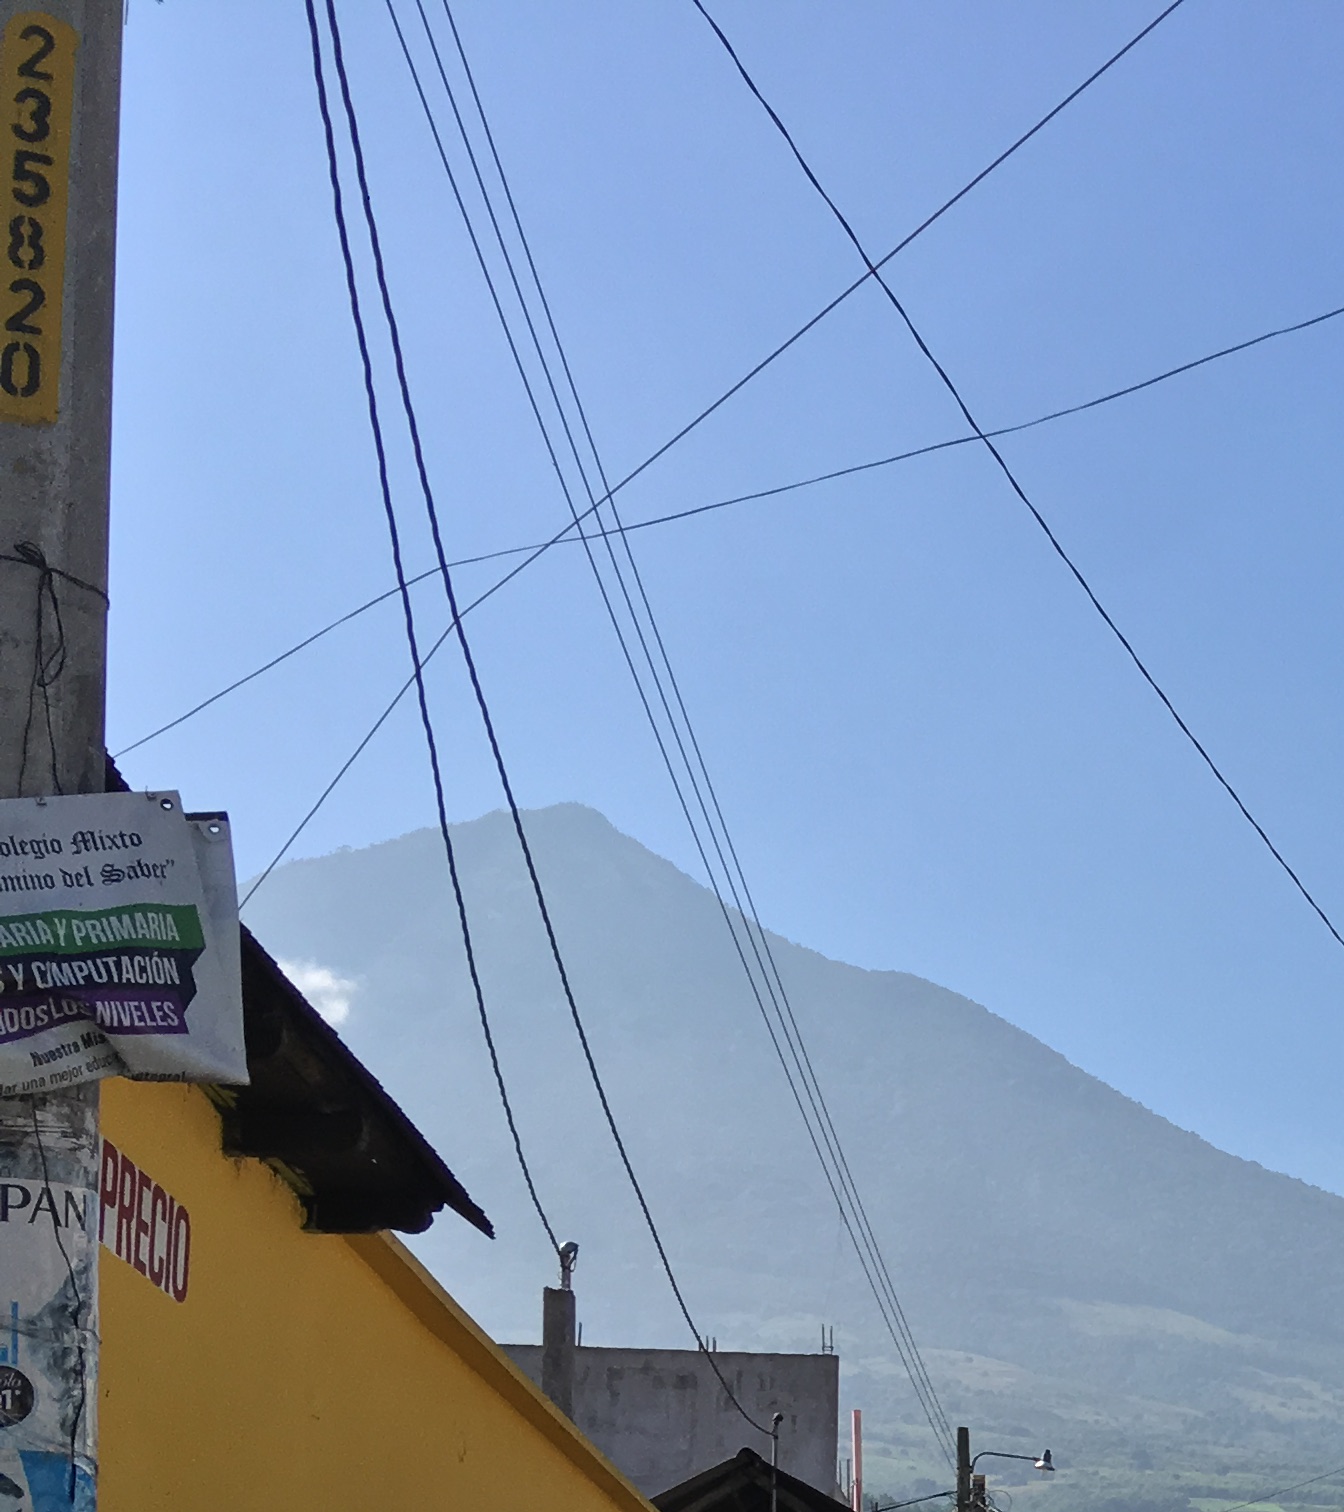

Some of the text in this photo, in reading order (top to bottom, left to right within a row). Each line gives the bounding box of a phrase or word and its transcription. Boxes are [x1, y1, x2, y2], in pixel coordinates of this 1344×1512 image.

[1, 25, 55, 398] 235820
[70, 830, 143, 855] Mixto
[0, 869, 56, 893] mino
[59, 866, 94, 888] del
[71, 911, 180, 946] PRIMARIA
[7, 963, 24, 990] Y
[95, 1001, 179, 1028] NIVELES
[99, 1138, 191, 1303] PRECIO
